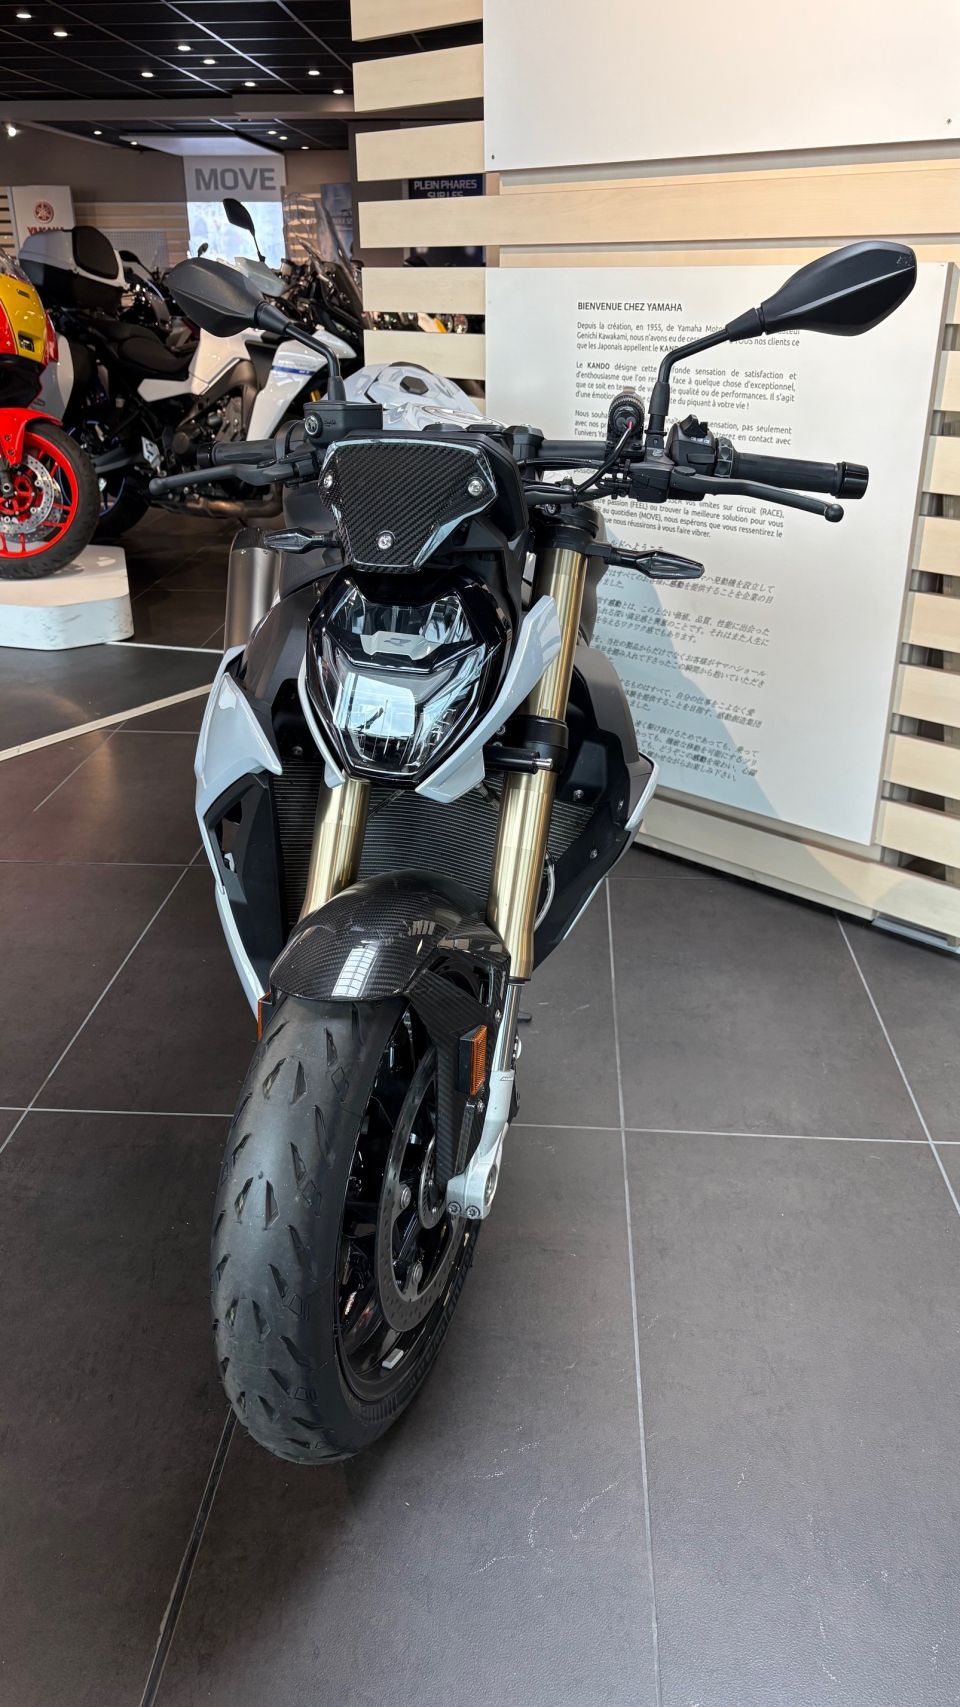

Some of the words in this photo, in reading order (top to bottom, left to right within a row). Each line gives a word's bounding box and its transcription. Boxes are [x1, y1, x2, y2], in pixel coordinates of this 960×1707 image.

[195, 168, 276, 191] MOVE
[414, 180, 440, 190] PLEIN
[440, 179, 478, 189] PHARES
[578, 302, 622, 311] BIENVENUE
[624, 303, 645, 311] CHEZ
[647, 303, 683, 311] YAMAHA
[577, 322, 597, 330] Depuis
[599, 322, 605, 330] la
[607, 322, 632, 331] création,
[647, 324, 663, 332] 1955,
[666, 324, 675, 332] de
[677, 324, 702, 332] Yamaha
[577, 332, 597, 340] Genichi
[599, 333, 628, 342] Kawakami,
[629, 334, 644, 342] nous
[677, 335, 686, 343] de
[754, 338, 766, 346] nos
[767, 337, 791, 346] clients
[792, 339, 800, 347] ce
[588, 342, 597, 350] les
[598, 342, 623, 352] Japonais
[623, 343, 651, 352] appellent
[652, 344, 659, 352] le
[587, 362, 610, 370] KANDO
[614, 363, 637, 372] désigne
[641, 365, 657, 373] cette
[695, 368, 726, 377] sensation
[731, 369, 740, 377] de
[744, 370, 784, 380] satisfaction
[789, 372, 797, 380] et
[672, 376, 686, 385] face
[687, 376, 692, 385] à
[694, 378, 720, 387] quelque
[722, 379, 742, 388] chose
[595, 382, 606, 390] soit
[637, 384, 646, 392] de
[678, 388, 700, 397] qualité
[711, 389, 720, 398] de
[721, 390, 768, 401] performances.
[769, 393, 775, 401] Il
[678, 396, 686, 405] du
[686, 398, 711, 408] piquant
[712, 399, 717, 408] à
[717, 400, 735, 409] votre
[736, 401, 746, 410] vie
[575, 410, 590, 418] Nous
[709, 421, 739, 431] ensation,
[741, 424, 754, 432] pas
[756, 425, 793, 435] seulement
[748, 435, 774, 444] contact
[775, 438, 791, 446] avec
[607, 499, 629, 507] passion
[630, 501, 648, 510] (FEEL)
[660, 505, 682, 514] trouver
[683, 507, 690, 515] la
[691, 509, 720, 519] meilleure
[722, 513, 748, 523] solution
[750, 518, 766, 527] pour
[768, 520, 784, 528] vous
[736, 505, 757, 514] circuit
[760, 508, 784, 519] (RACE),
[611, 508, 638, 518] quotidien
[680, 518, 708, 527] espérons
[709, 522, 721, 530] que
[722, 524, 737, 532] vous
[738, 526, 775, 537] ressentirez
[776, 530, 783, 538] le
[627, 519, 656, 529] réussirons
[657, 523, 661, 531] à
[662, 525, 676, 533] vous
[676, 526, 691, 535] faire
[692, 528, 711, 538] vibrer.
